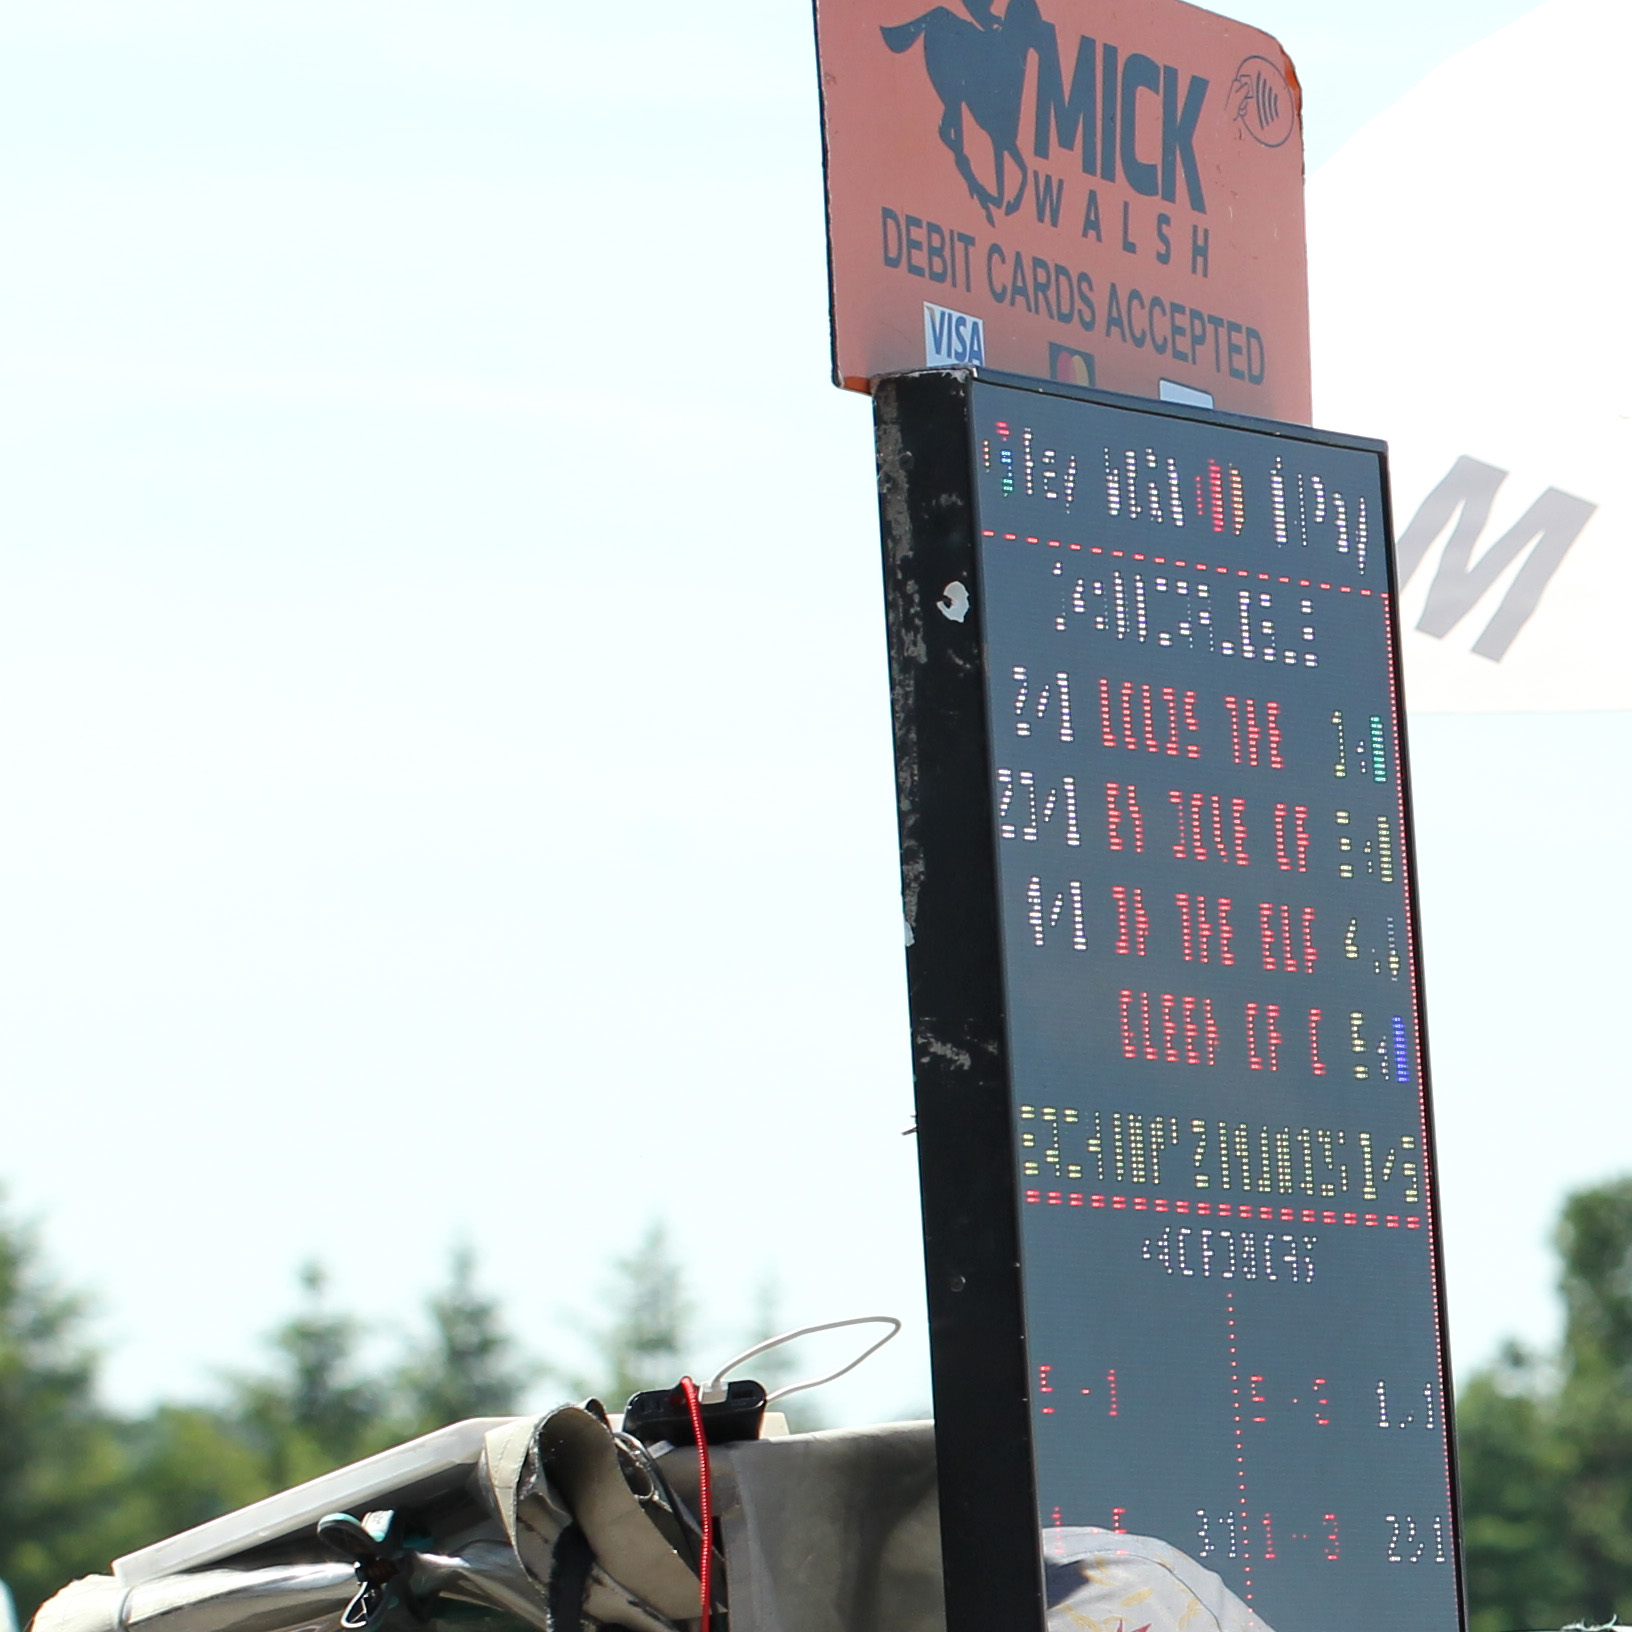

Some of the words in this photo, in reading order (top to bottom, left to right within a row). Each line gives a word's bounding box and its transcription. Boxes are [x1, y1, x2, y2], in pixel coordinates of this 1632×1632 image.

[1033, 34, 1210, 214] MICK
[881, 206, 976, 293] DEBIT
[987, 243, 1096, 332] CARDS
[1105, 282, 1266, 386] ACCEPTED
[1033, 170, 1210, 278] WALSH
[928, 309, 984, 365] VISA
